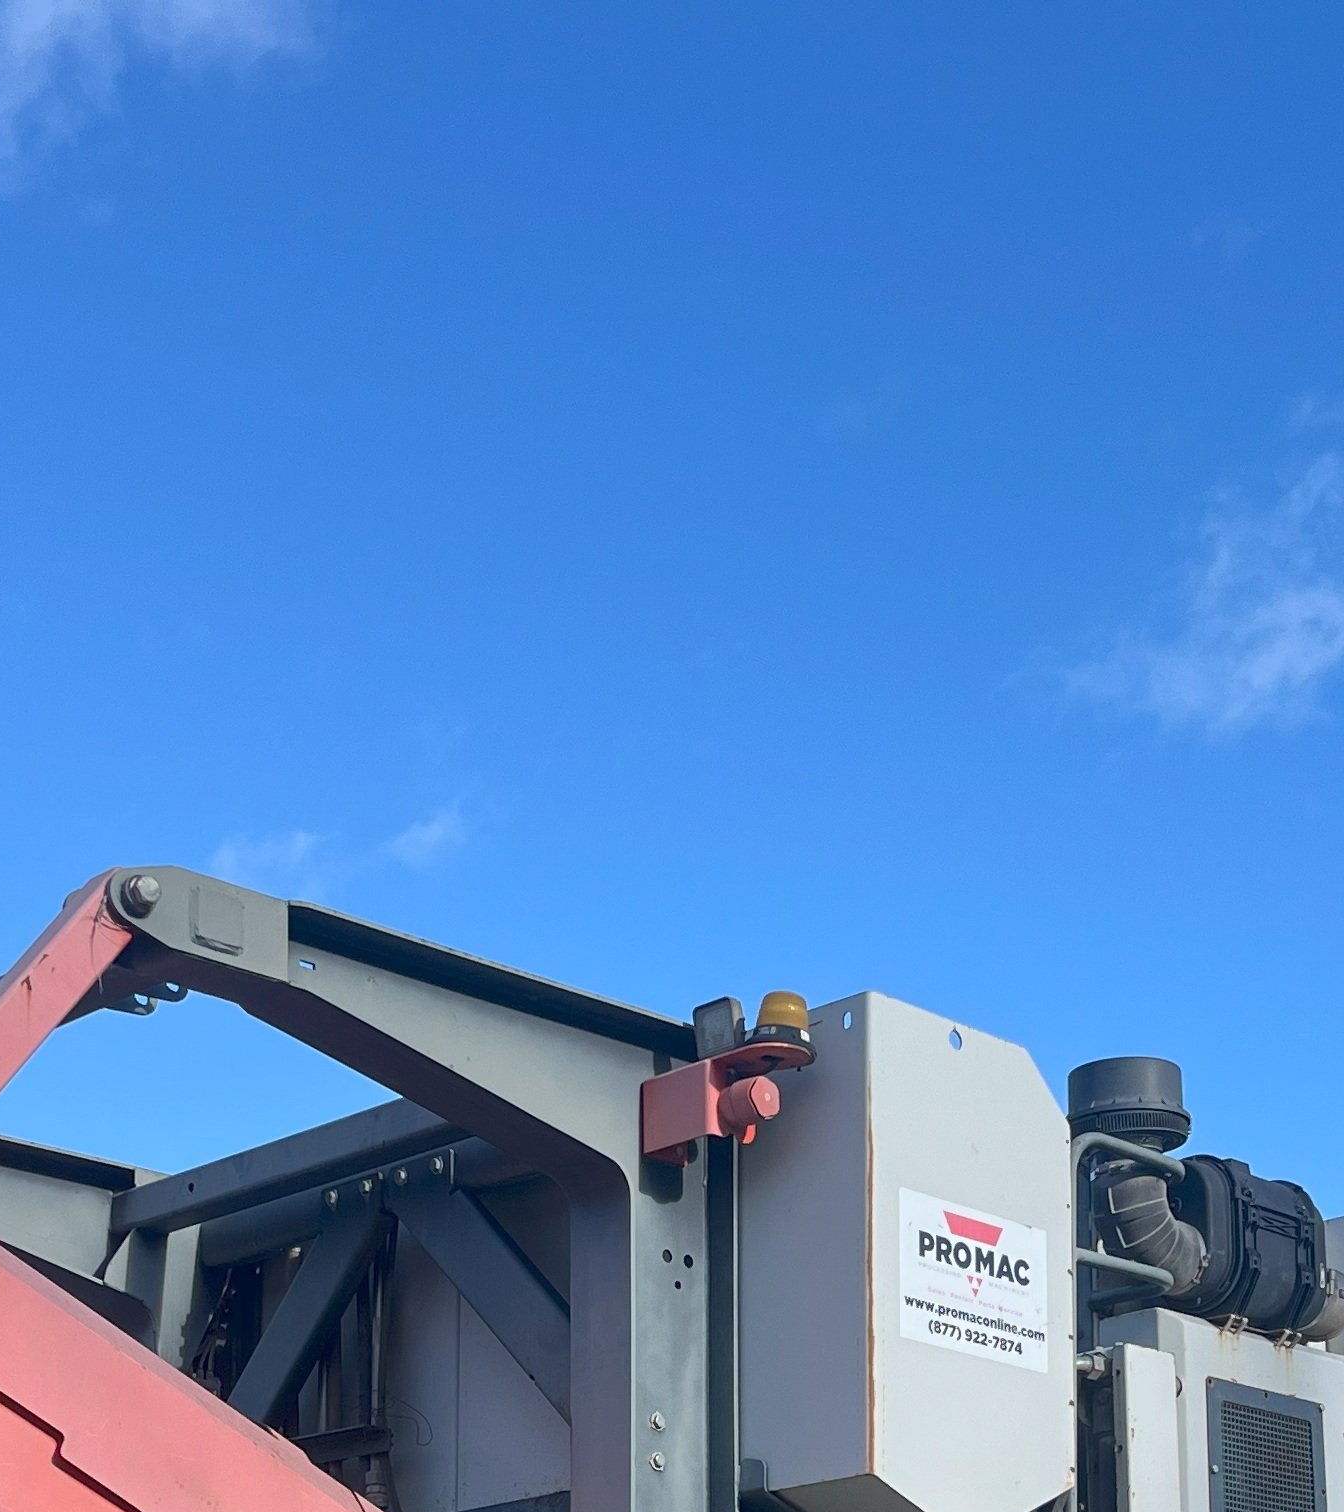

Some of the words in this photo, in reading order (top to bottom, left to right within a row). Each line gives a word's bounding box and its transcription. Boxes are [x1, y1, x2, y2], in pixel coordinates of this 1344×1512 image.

[918, 1229, 1030, 1286] PROMAC
[904, 1295, 1045, 1342] www.promaconline.com
[928, 1319, 962, 1341] (877)
[965, 1328, 1023, 1355] 922-7874
